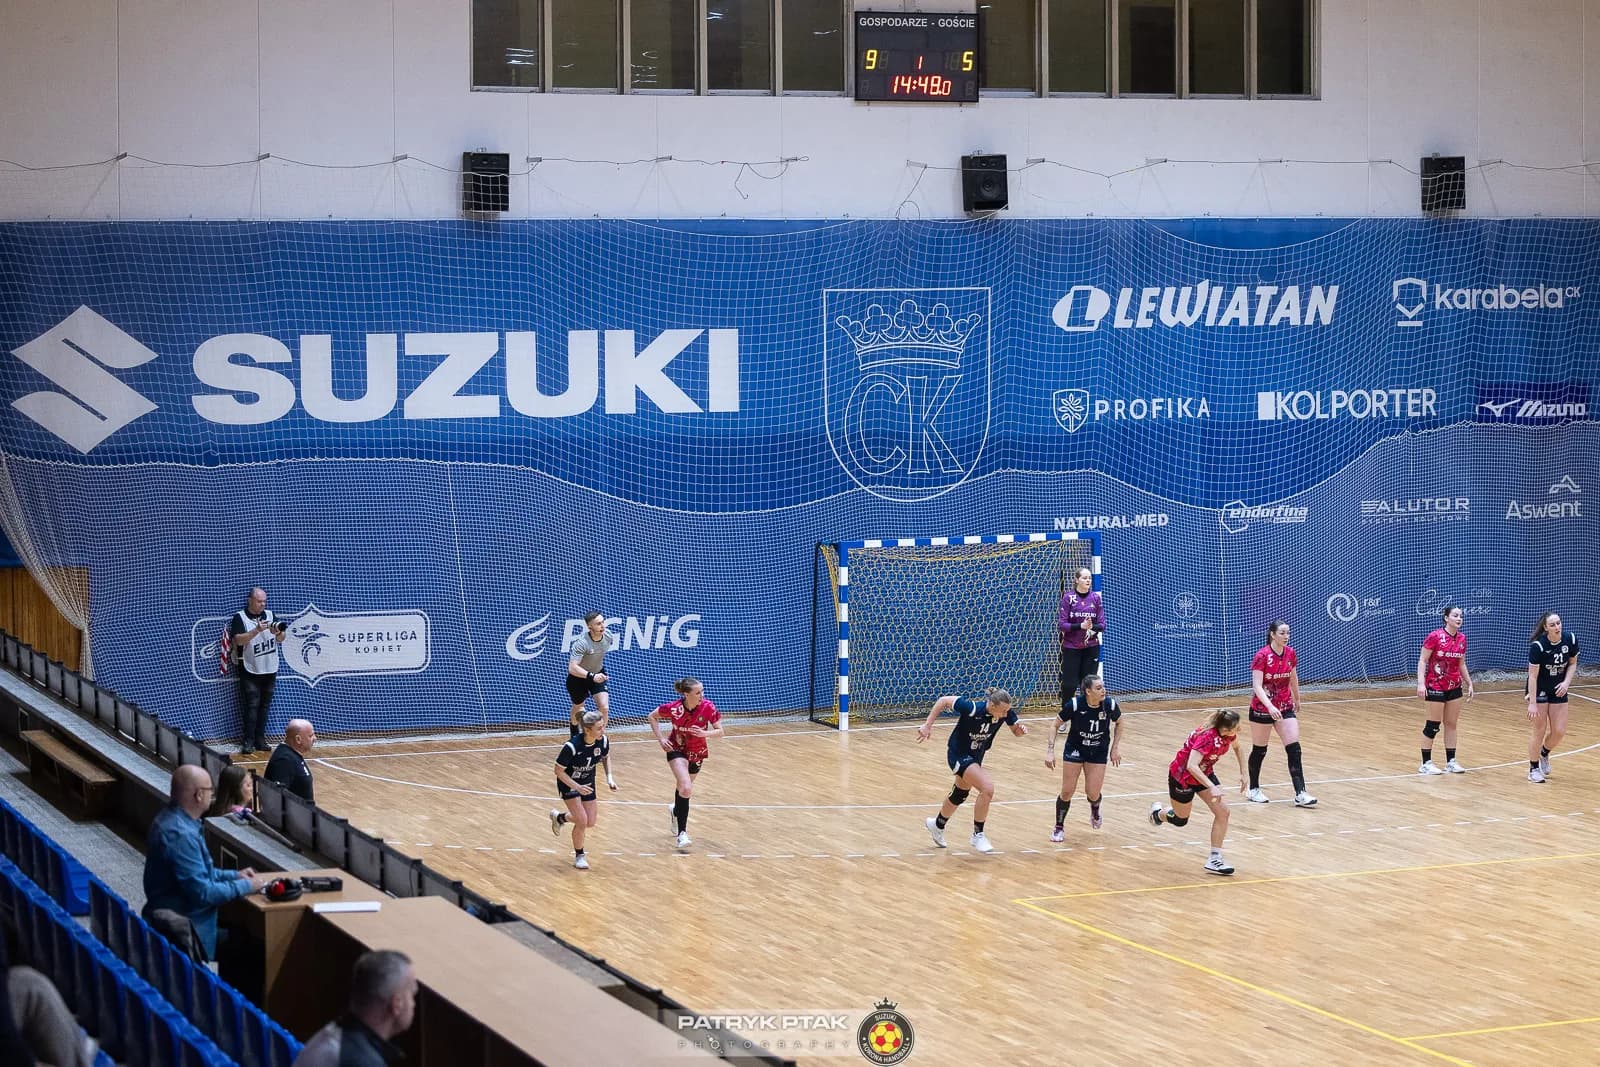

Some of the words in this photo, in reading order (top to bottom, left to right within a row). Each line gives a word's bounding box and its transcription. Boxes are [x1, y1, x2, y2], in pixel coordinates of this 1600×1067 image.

[859, 17, 928, 27] GOSPODARZE
[938, 16, 975, 28] GOŚCIE
[865, 49, 878, 70] 9
[916, 56, 923, 70] 1
[962, 51, 974, 71] 5
[1113, 279, 1340, 328] LEWIATAN
[1435, 284, 1563, 310] karabela
[1565, 286, 1581, 298] CK
[192, 328, 740, 425] SUZUKI
[1094, 397, 1211, 421] PROFIKA
[1276, 388, 1437, 420] KOLPORTER
[1229, 505, 1309, 519] endorfina
[1376, 497, 1470, 513] ALUTOR
[1506, 500, 1581, 519] Aswent
[1054, 513, 1169, 530] NATURAL-MED
[338, 630, 417, 648] SUPERLIGA
[355, 644, 402, 654] KOBIET
[1553, 653, 1564, 664] 21
[1089, 719, 1100, 732] 71
[586, 756, 593, 768] 7
